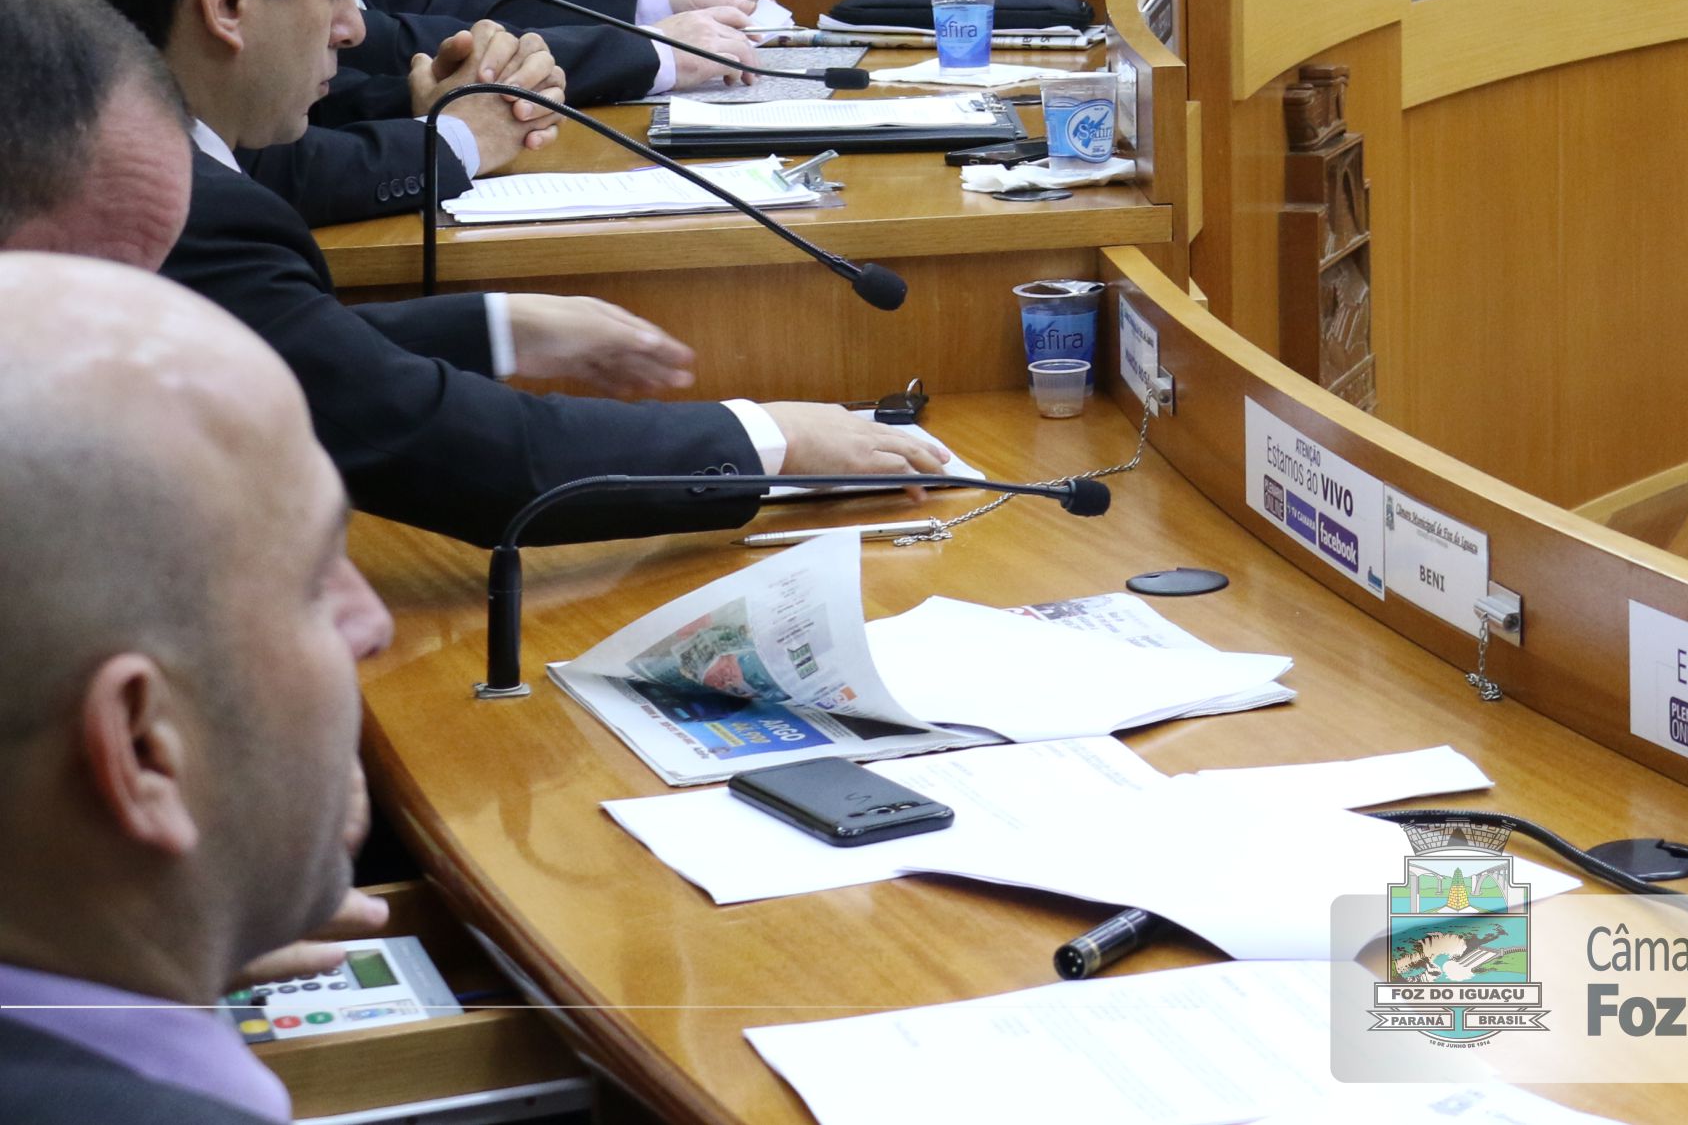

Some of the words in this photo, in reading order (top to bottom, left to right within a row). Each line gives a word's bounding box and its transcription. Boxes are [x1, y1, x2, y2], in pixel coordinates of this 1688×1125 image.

[935, 20, 978, 38] afira
[1029, 329, 1084, 351] afira
[1296, 437, 1322, 468] ATENÇÃO
[1266, 435, 1304, 487] Estamos
[1306, 468, 1319, 496] ao
[1321, 472, 1354, 518] VIVO
[1320, 521, 1358, 566] facebook
[1419, 564, 1446, 593] BENI
